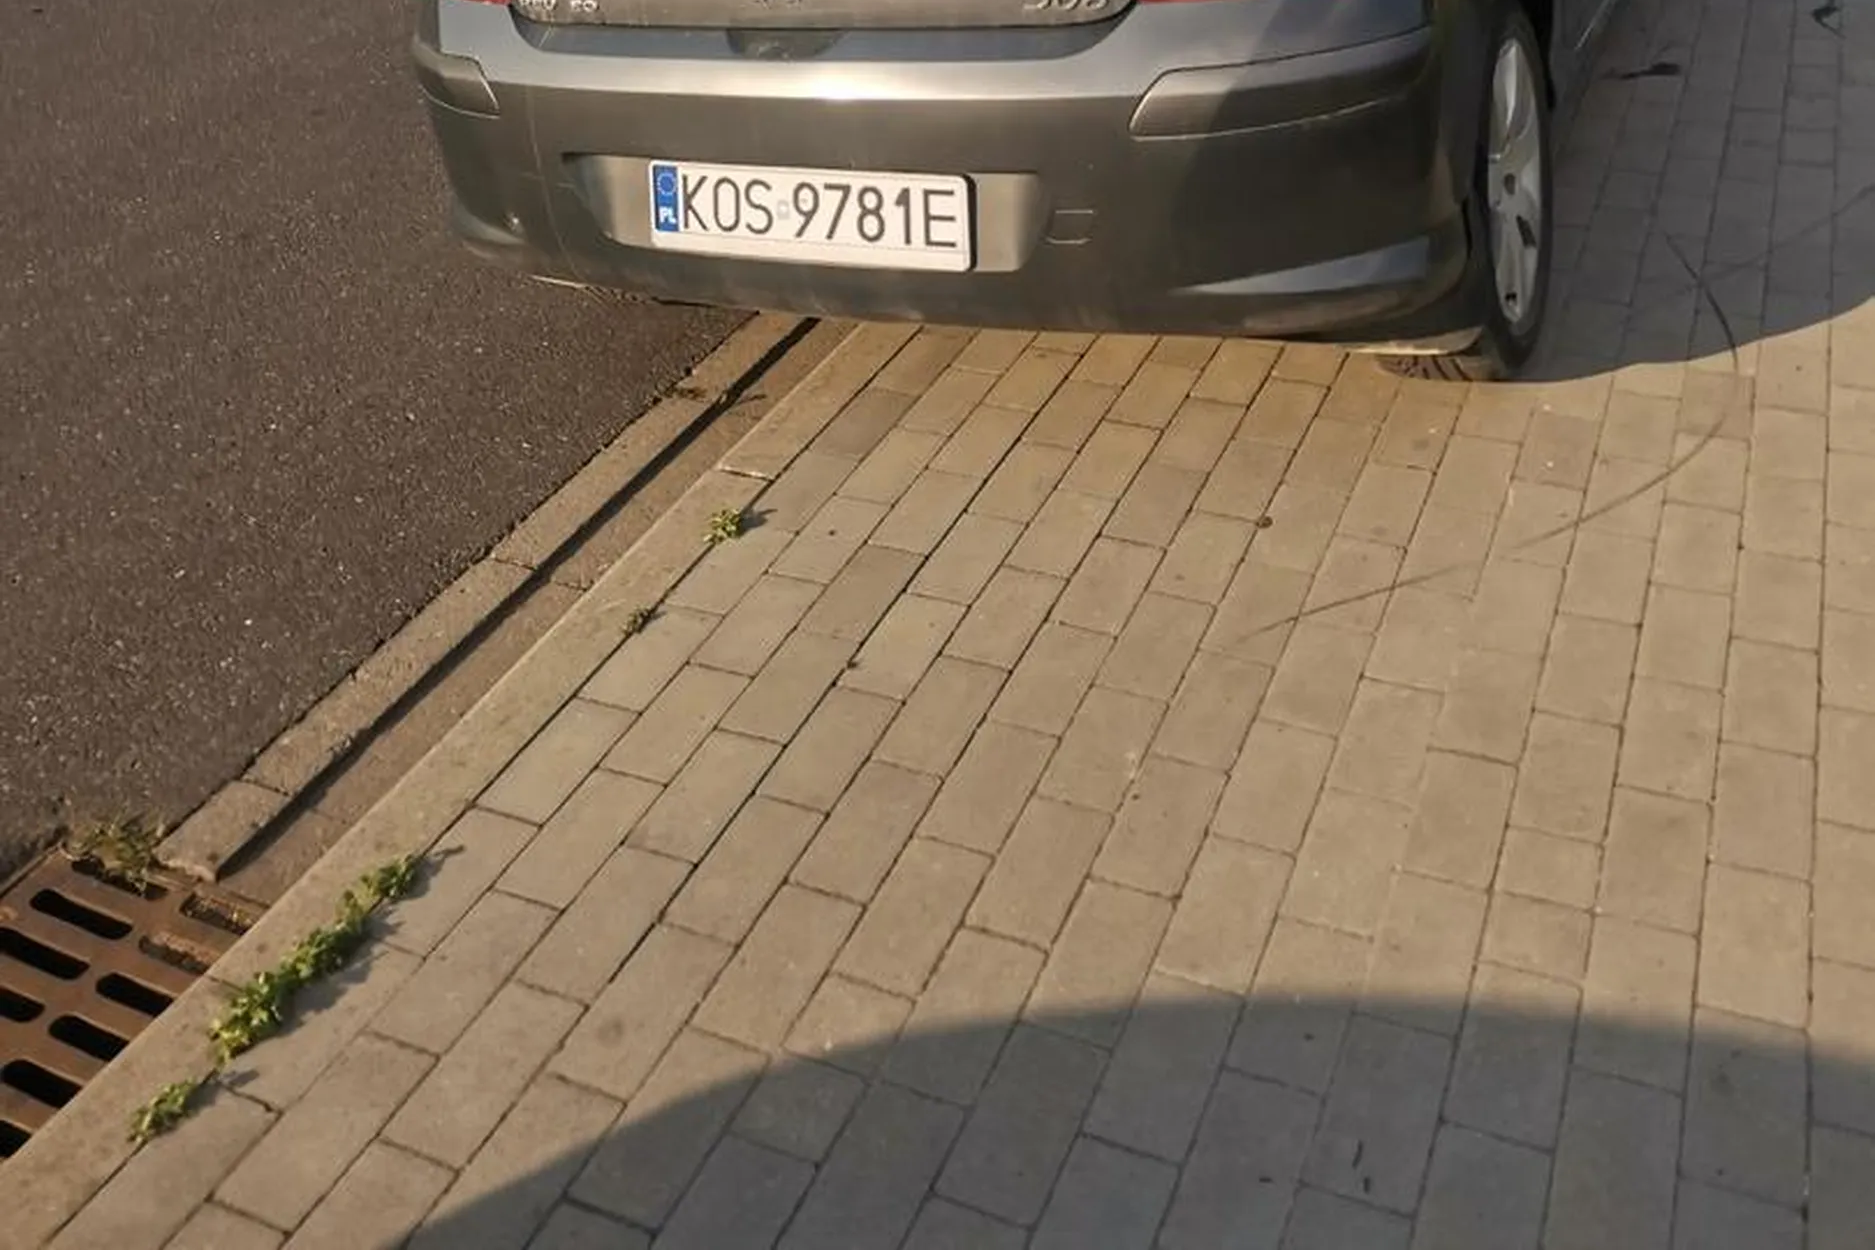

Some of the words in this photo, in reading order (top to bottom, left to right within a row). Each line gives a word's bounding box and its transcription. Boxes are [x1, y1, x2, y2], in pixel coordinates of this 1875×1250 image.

[659, 206, 677, 225] PL
[682, 173, 774, 236] KOS
[792, 181, 957, 249] 9781E
